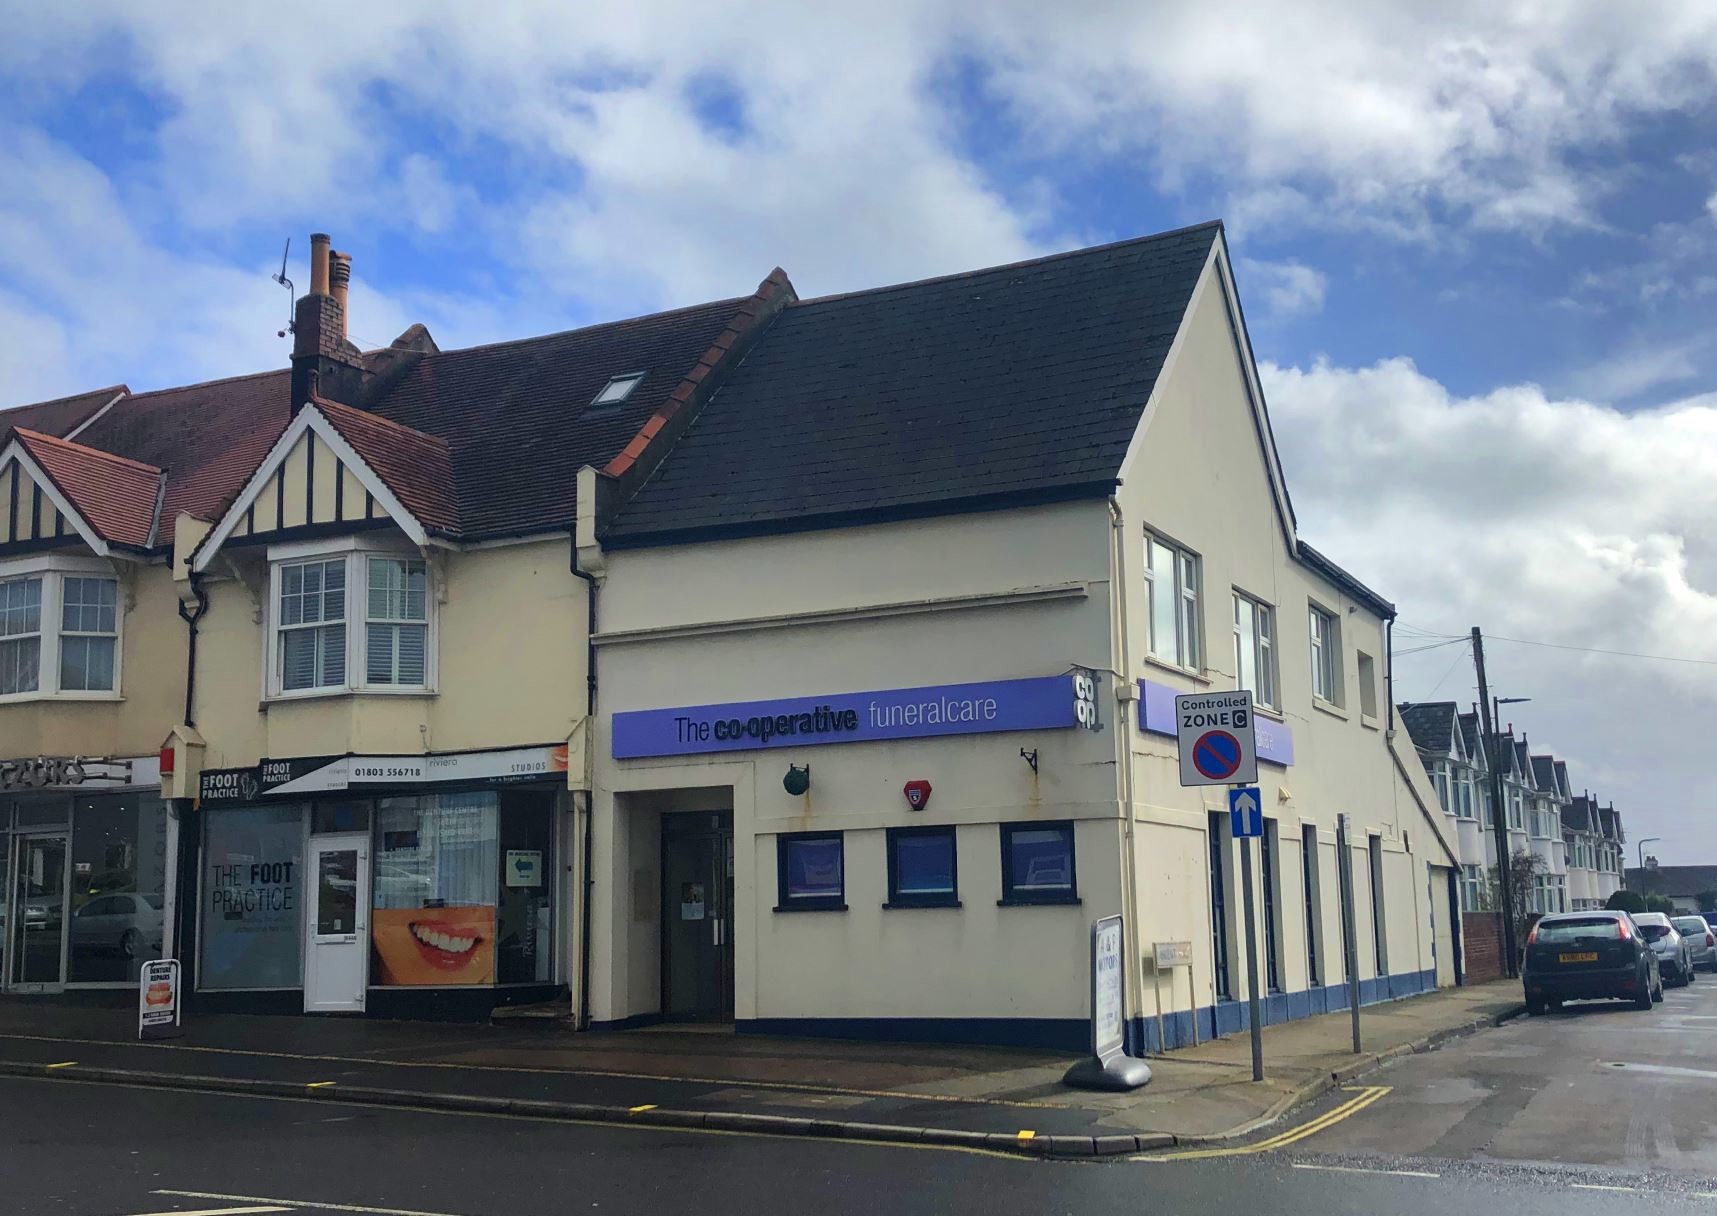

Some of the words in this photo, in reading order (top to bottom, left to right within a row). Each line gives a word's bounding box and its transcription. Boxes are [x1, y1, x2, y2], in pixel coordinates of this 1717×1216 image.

[1181, 696, 1247, 711] Controlled
[675, 716, 709, 744] The
[868, 695, 998, 729] funeralcare
[1183, 713, 1230, 728] ZONE
[1233, 711, 1246, 727] C
[268, 762, 291, 774] FOOT
[355, 768, 384, 776] 01803
[386, 767, 421, 776] 556718
[511, 762, 546, 773] STUDIOS
[209, 773, 239, 788] FOOT
[262, 773, 291, 783] PRACTICE
[202, 788, 239, 799] PRACTICE
[211, 864, 242, 887] THE
[251, 861, 294, 885] FOOT
[212, 886, 293, 913] PRACTICE
[150, 966, 172, 975] DENTURE
